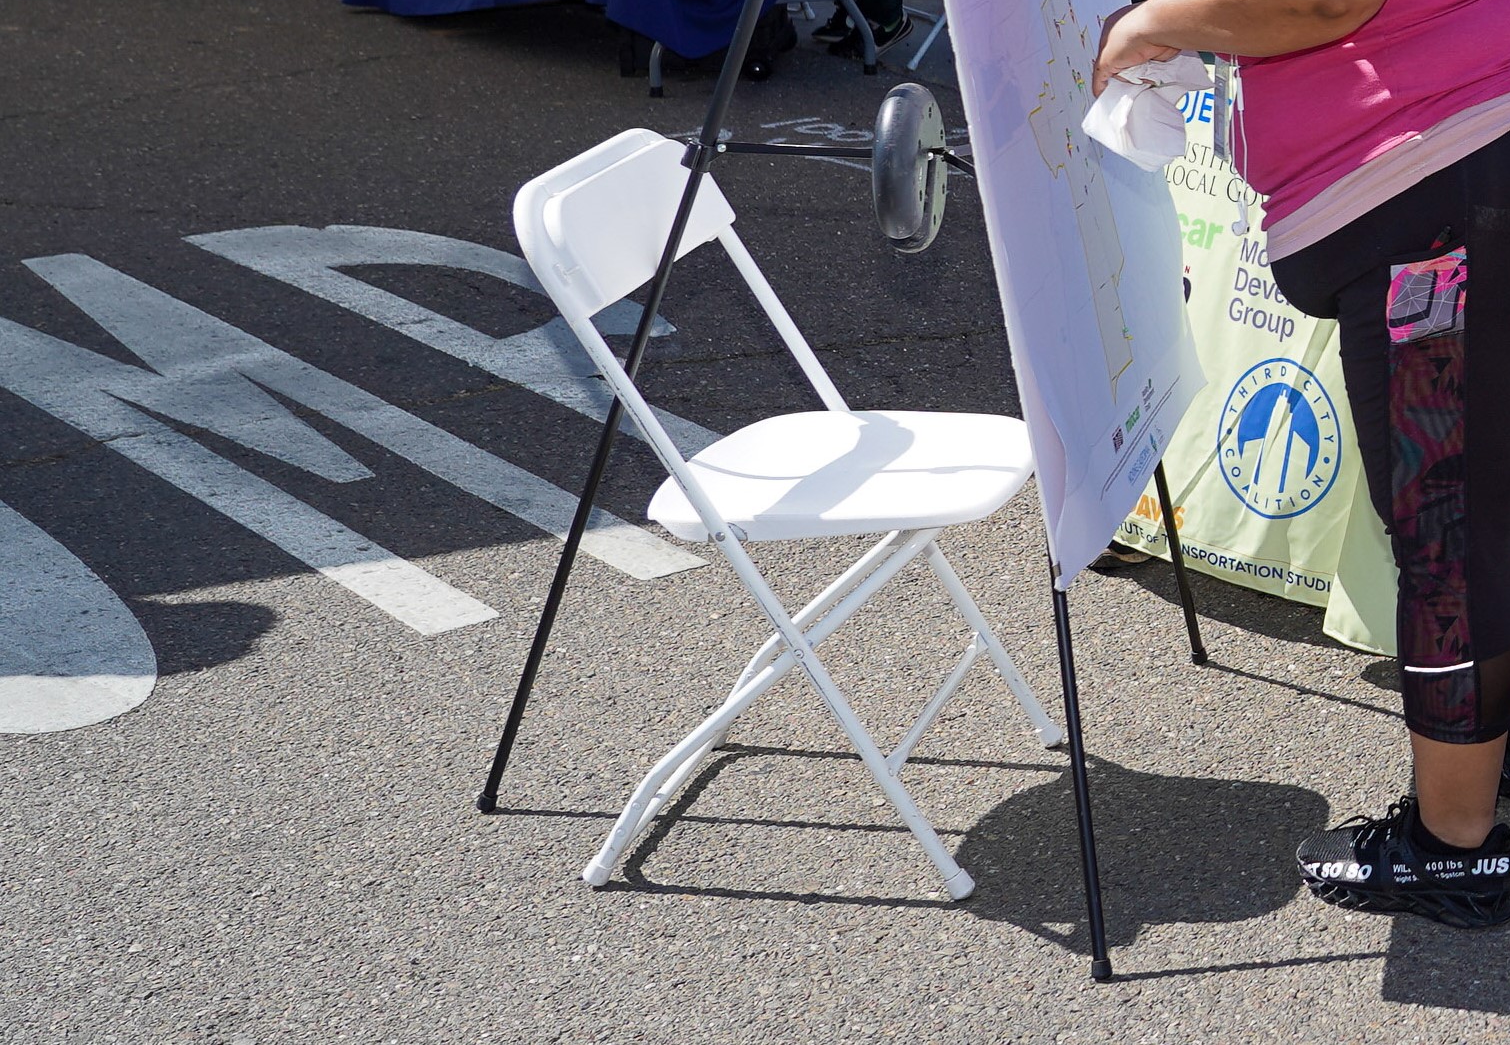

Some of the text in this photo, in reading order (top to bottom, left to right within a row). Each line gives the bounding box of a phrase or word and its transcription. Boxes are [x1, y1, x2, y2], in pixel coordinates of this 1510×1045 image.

[1239, 237, 1270, 268] Mo
[1234, 267, 1291, 306] Deve
[1229, 297, 1296, 343] Group
[1229, 365, 1335, 444] THIRD CITY
[1225, 448, 1326, 511] COALITION
[1146, 533, 1160, 545] OF
[1286, 570, 1331, 593] STUDI
[1321, 862, 1345, 879] SO
[1346, 862, 1373, 880] SO
[1425, 861, 1444, 871] 400
[1446, 860, 1464, 870] lbs
